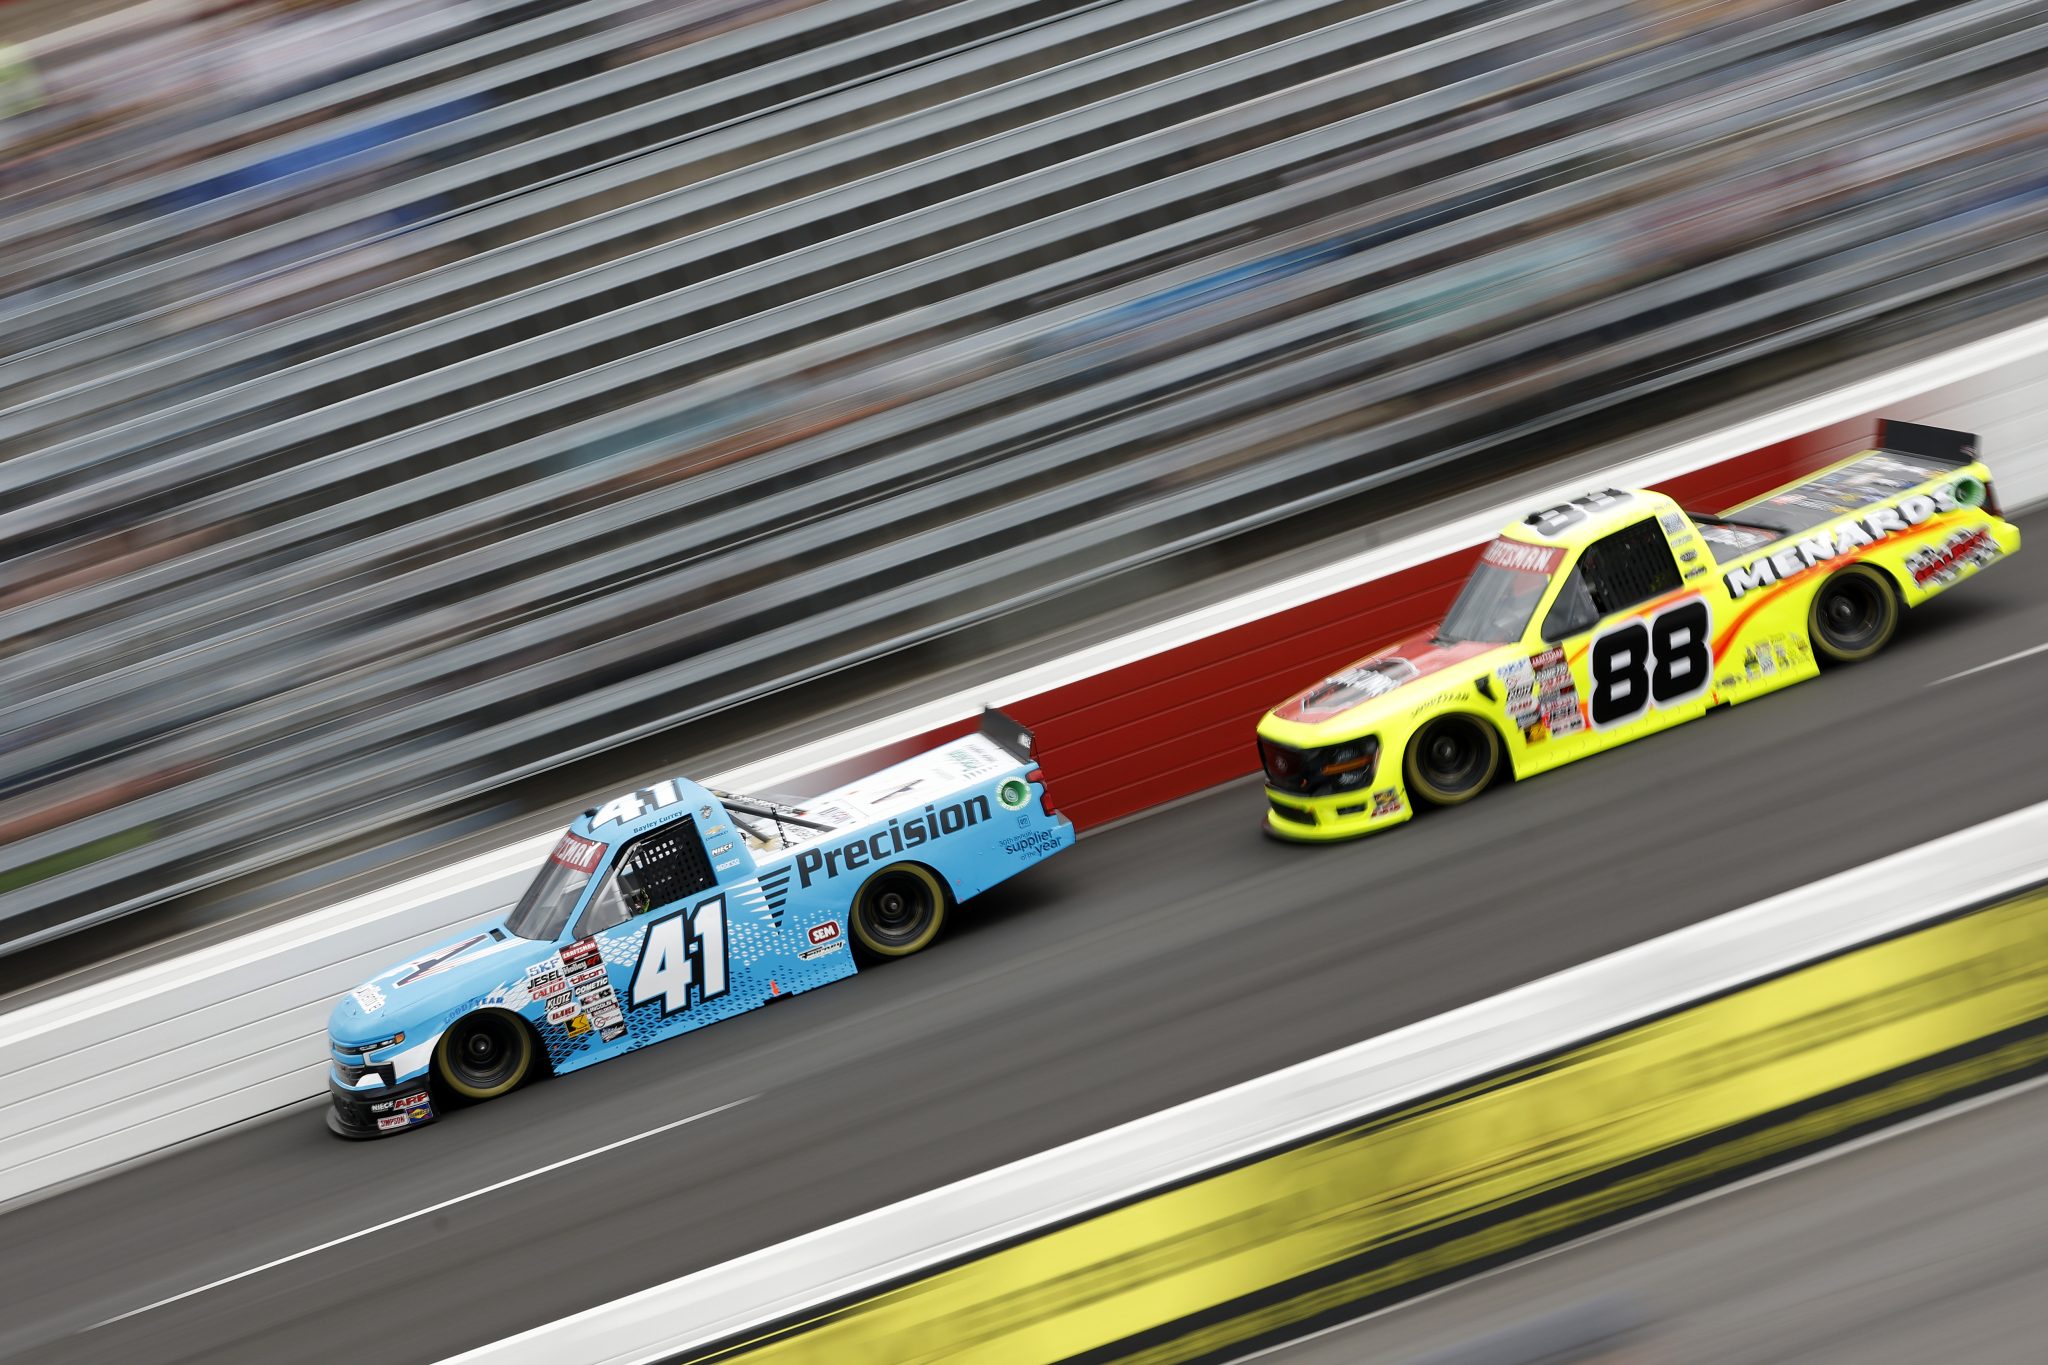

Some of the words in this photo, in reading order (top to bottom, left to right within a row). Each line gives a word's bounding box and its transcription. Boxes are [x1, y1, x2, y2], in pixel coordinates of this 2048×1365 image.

[1723, 484, 1957, 599] MENARDS
[1591, 601, 1711, 725] 88
[589, 778, 683, 833] 41
[633, 820, 658, 834] Bayley
[659, 810, 683, 824] Currey
[796, 794, 992, 889] Precision
[1005, 828, 1054, 855] supplier
[1034, 836, 1062, 858] year
[812, 924, 837, 942] SEM
[629, 893, 729, 1019] 41
[529, 957, 561, 978] SKF
[527, 969, 563, 990] JESEL
[575, 977, 609, 996] COMETIC
[533, 982, 566, 1001] CALICO
[545, 991, 572, 1012] KLOTZ
[371, 1101, 394, 1112] NIECE
[394, 1091, 430, 1110] ARP
[380, 1115, 405, 1127] SIMPSON
